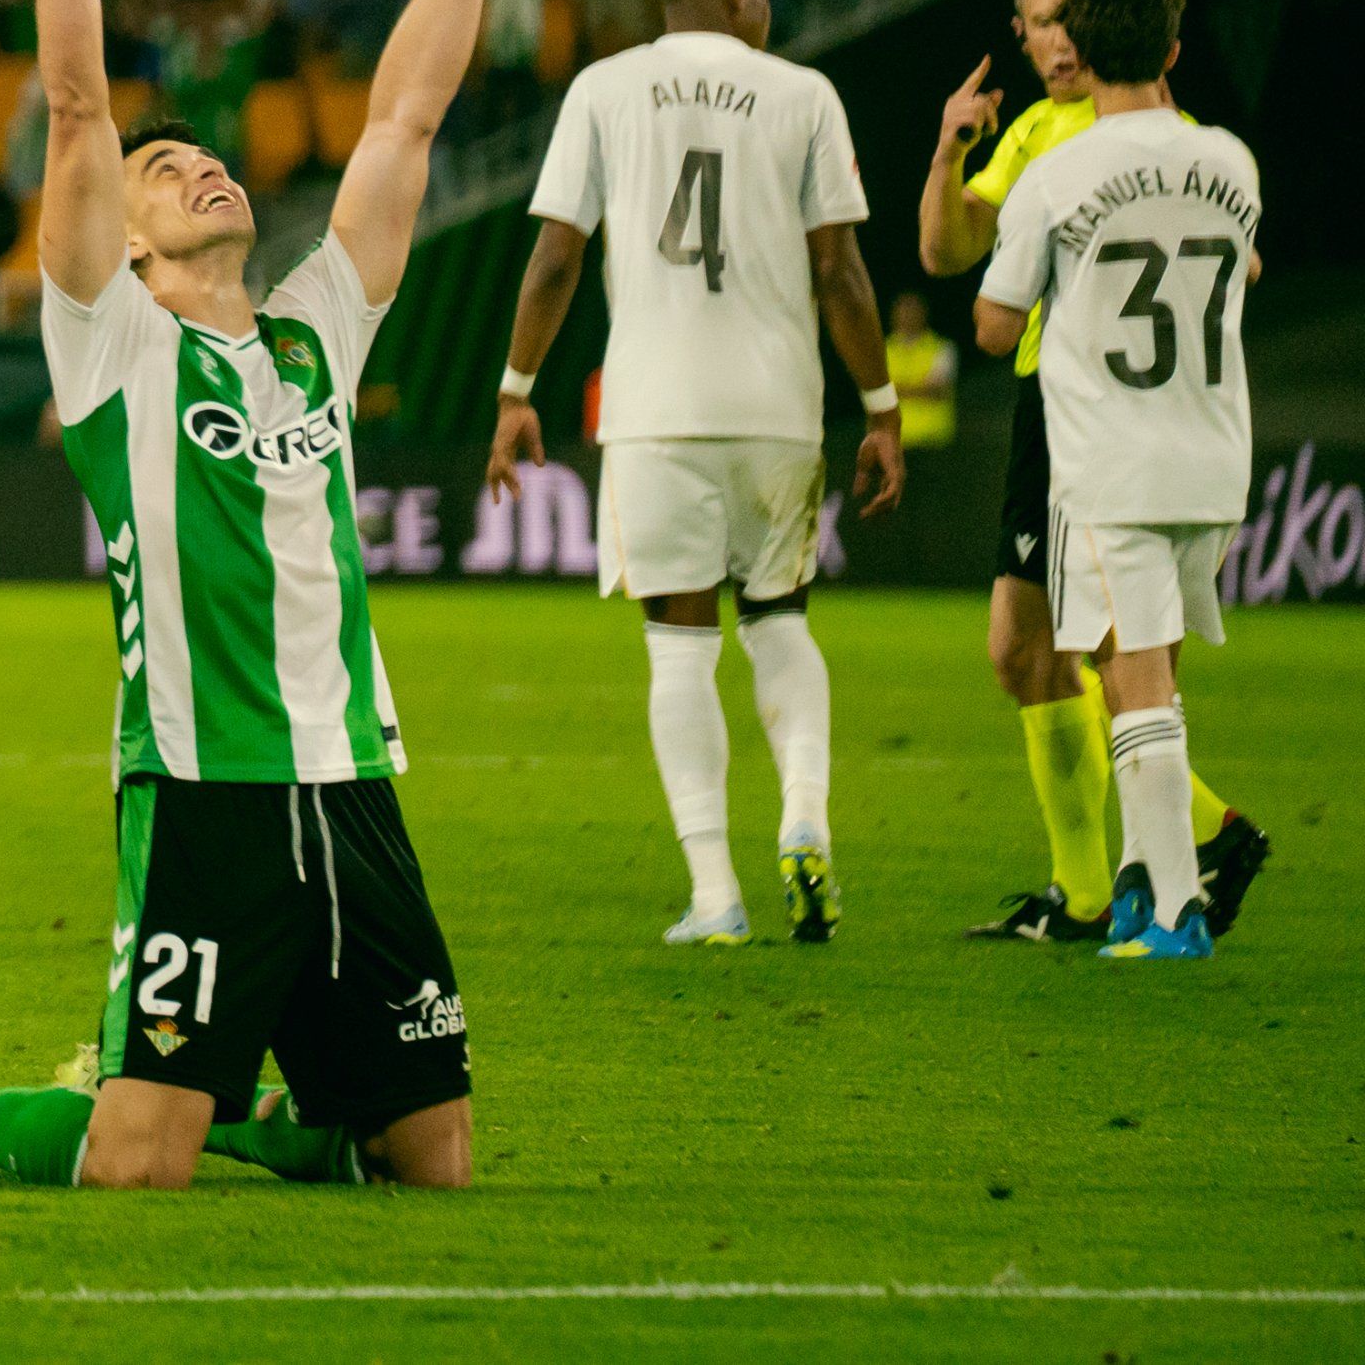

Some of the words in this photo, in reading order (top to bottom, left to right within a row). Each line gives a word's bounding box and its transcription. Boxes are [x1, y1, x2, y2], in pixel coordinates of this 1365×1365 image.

[652, 76, 757, 118] ALABA
[658, 147, 726, 293] 4
[1095, 236, 1238, 389] 37
[137, 932, 219, 1025] 21
[398, 1013, 467, 1042] GLOB
